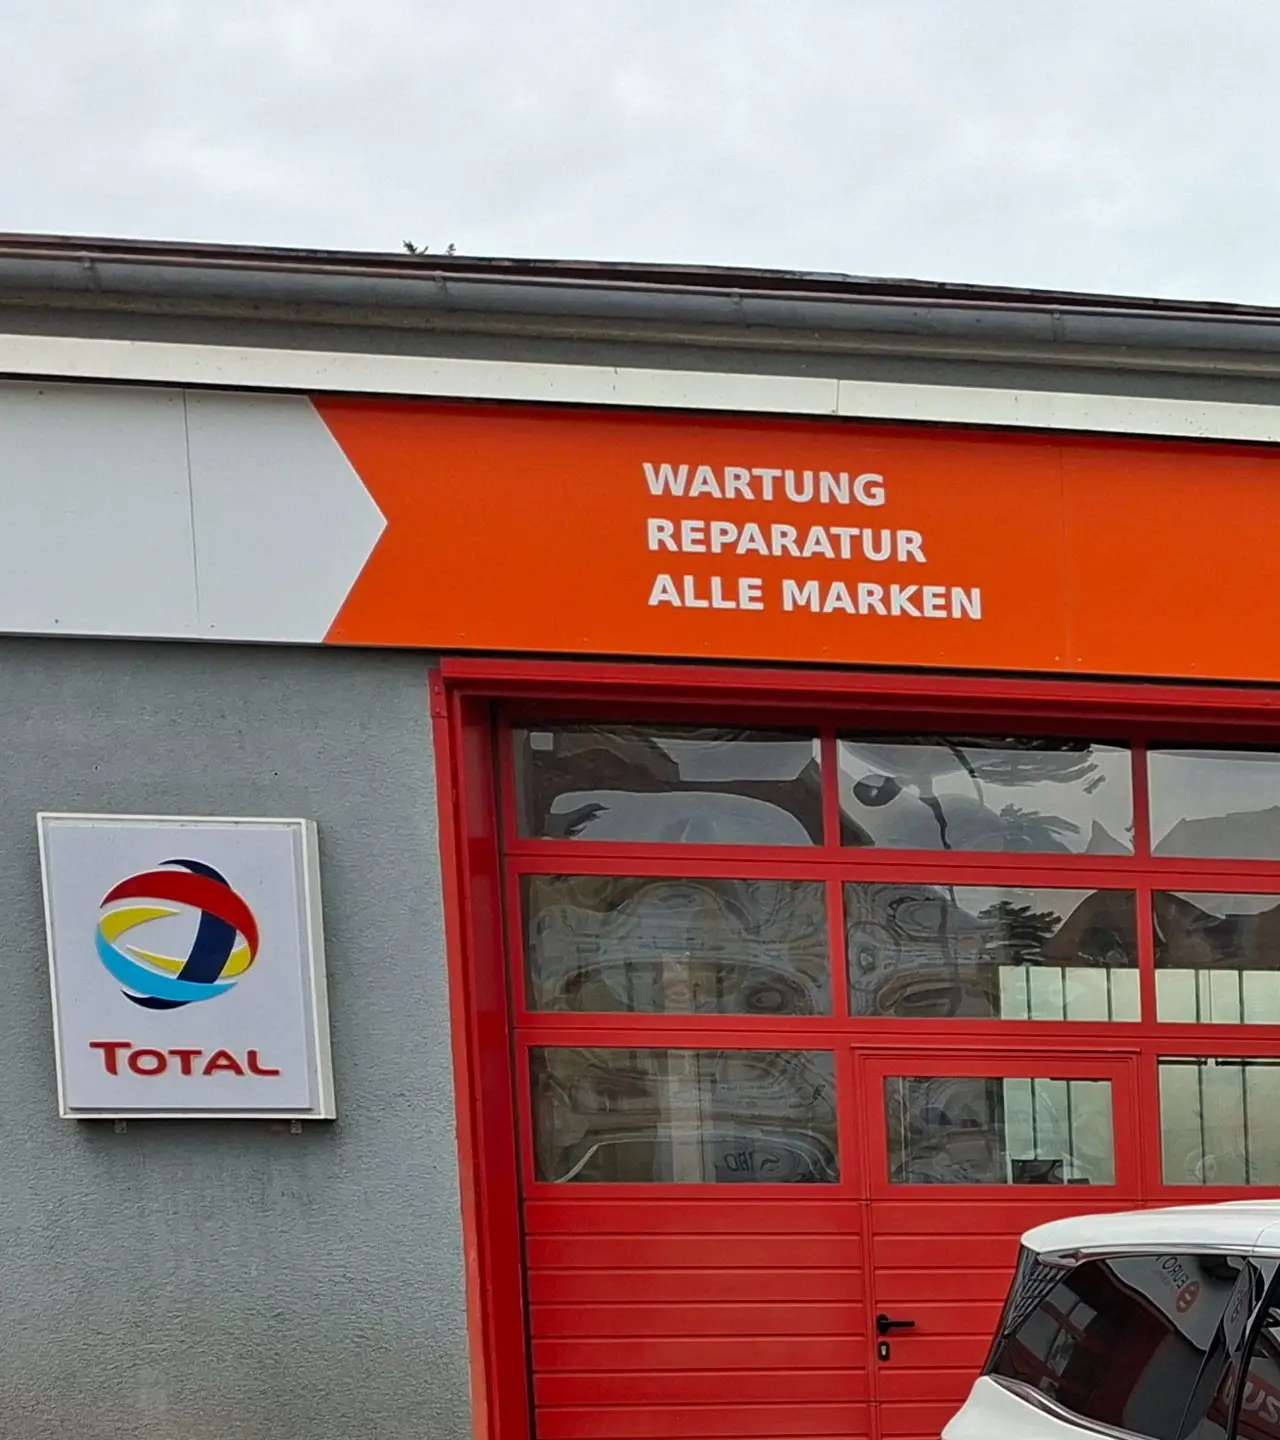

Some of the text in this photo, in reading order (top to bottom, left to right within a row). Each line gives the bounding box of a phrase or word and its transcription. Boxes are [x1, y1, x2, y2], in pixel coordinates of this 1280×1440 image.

[642, 462, 885, 507] WARTUNG
[646, 518, 927, 563] REPARATUR
[648, 574, 982, 620] ALLE MARKEN
[89, 1041, 281, 1077] TOTAL
